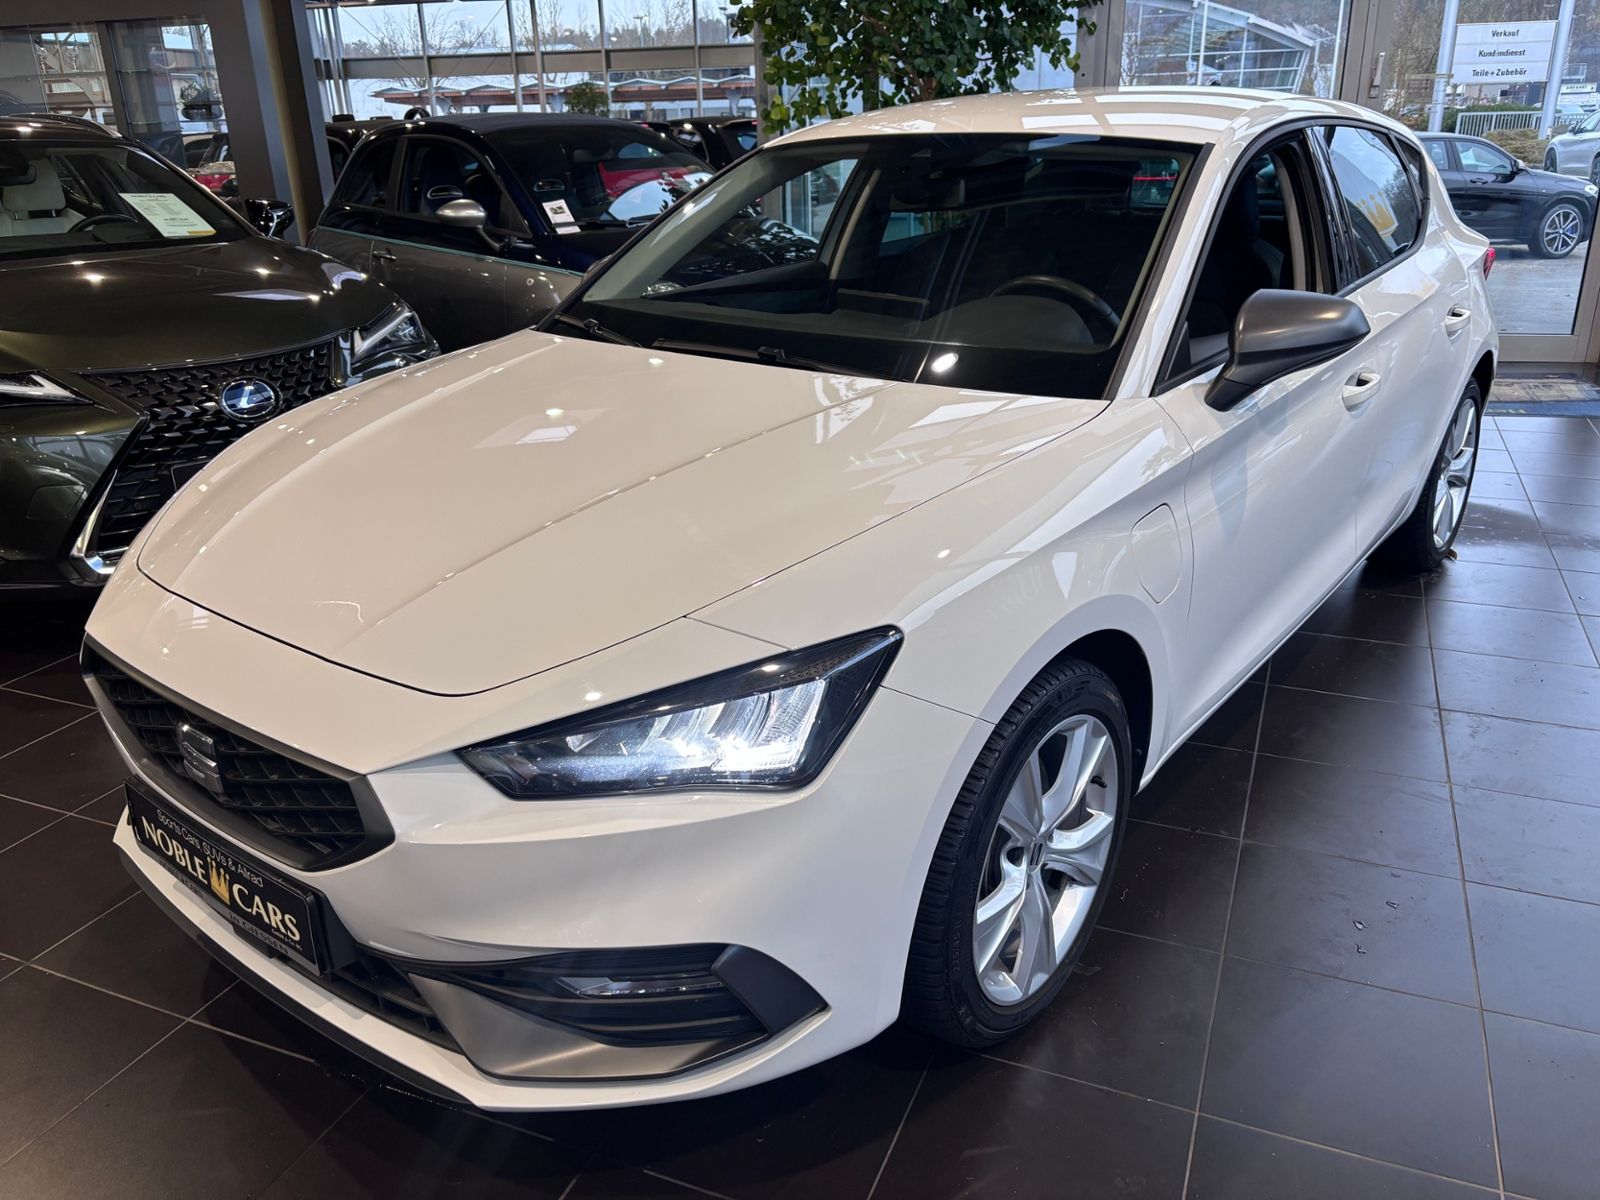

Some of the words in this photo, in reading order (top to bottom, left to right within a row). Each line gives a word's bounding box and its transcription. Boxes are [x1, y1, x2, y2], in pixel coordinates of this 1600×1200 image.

[1491, 29, 1520, 38] Verkauf
[141, 815, 208, 885] NOBLE
[232, 883, 300, 942] CARS
[156, 809, 181, 836] Sports
[202, 841, 227, 866] SUVs
[227, 857, 236, 872] &
[237, 864, 264, 888] Allrad
